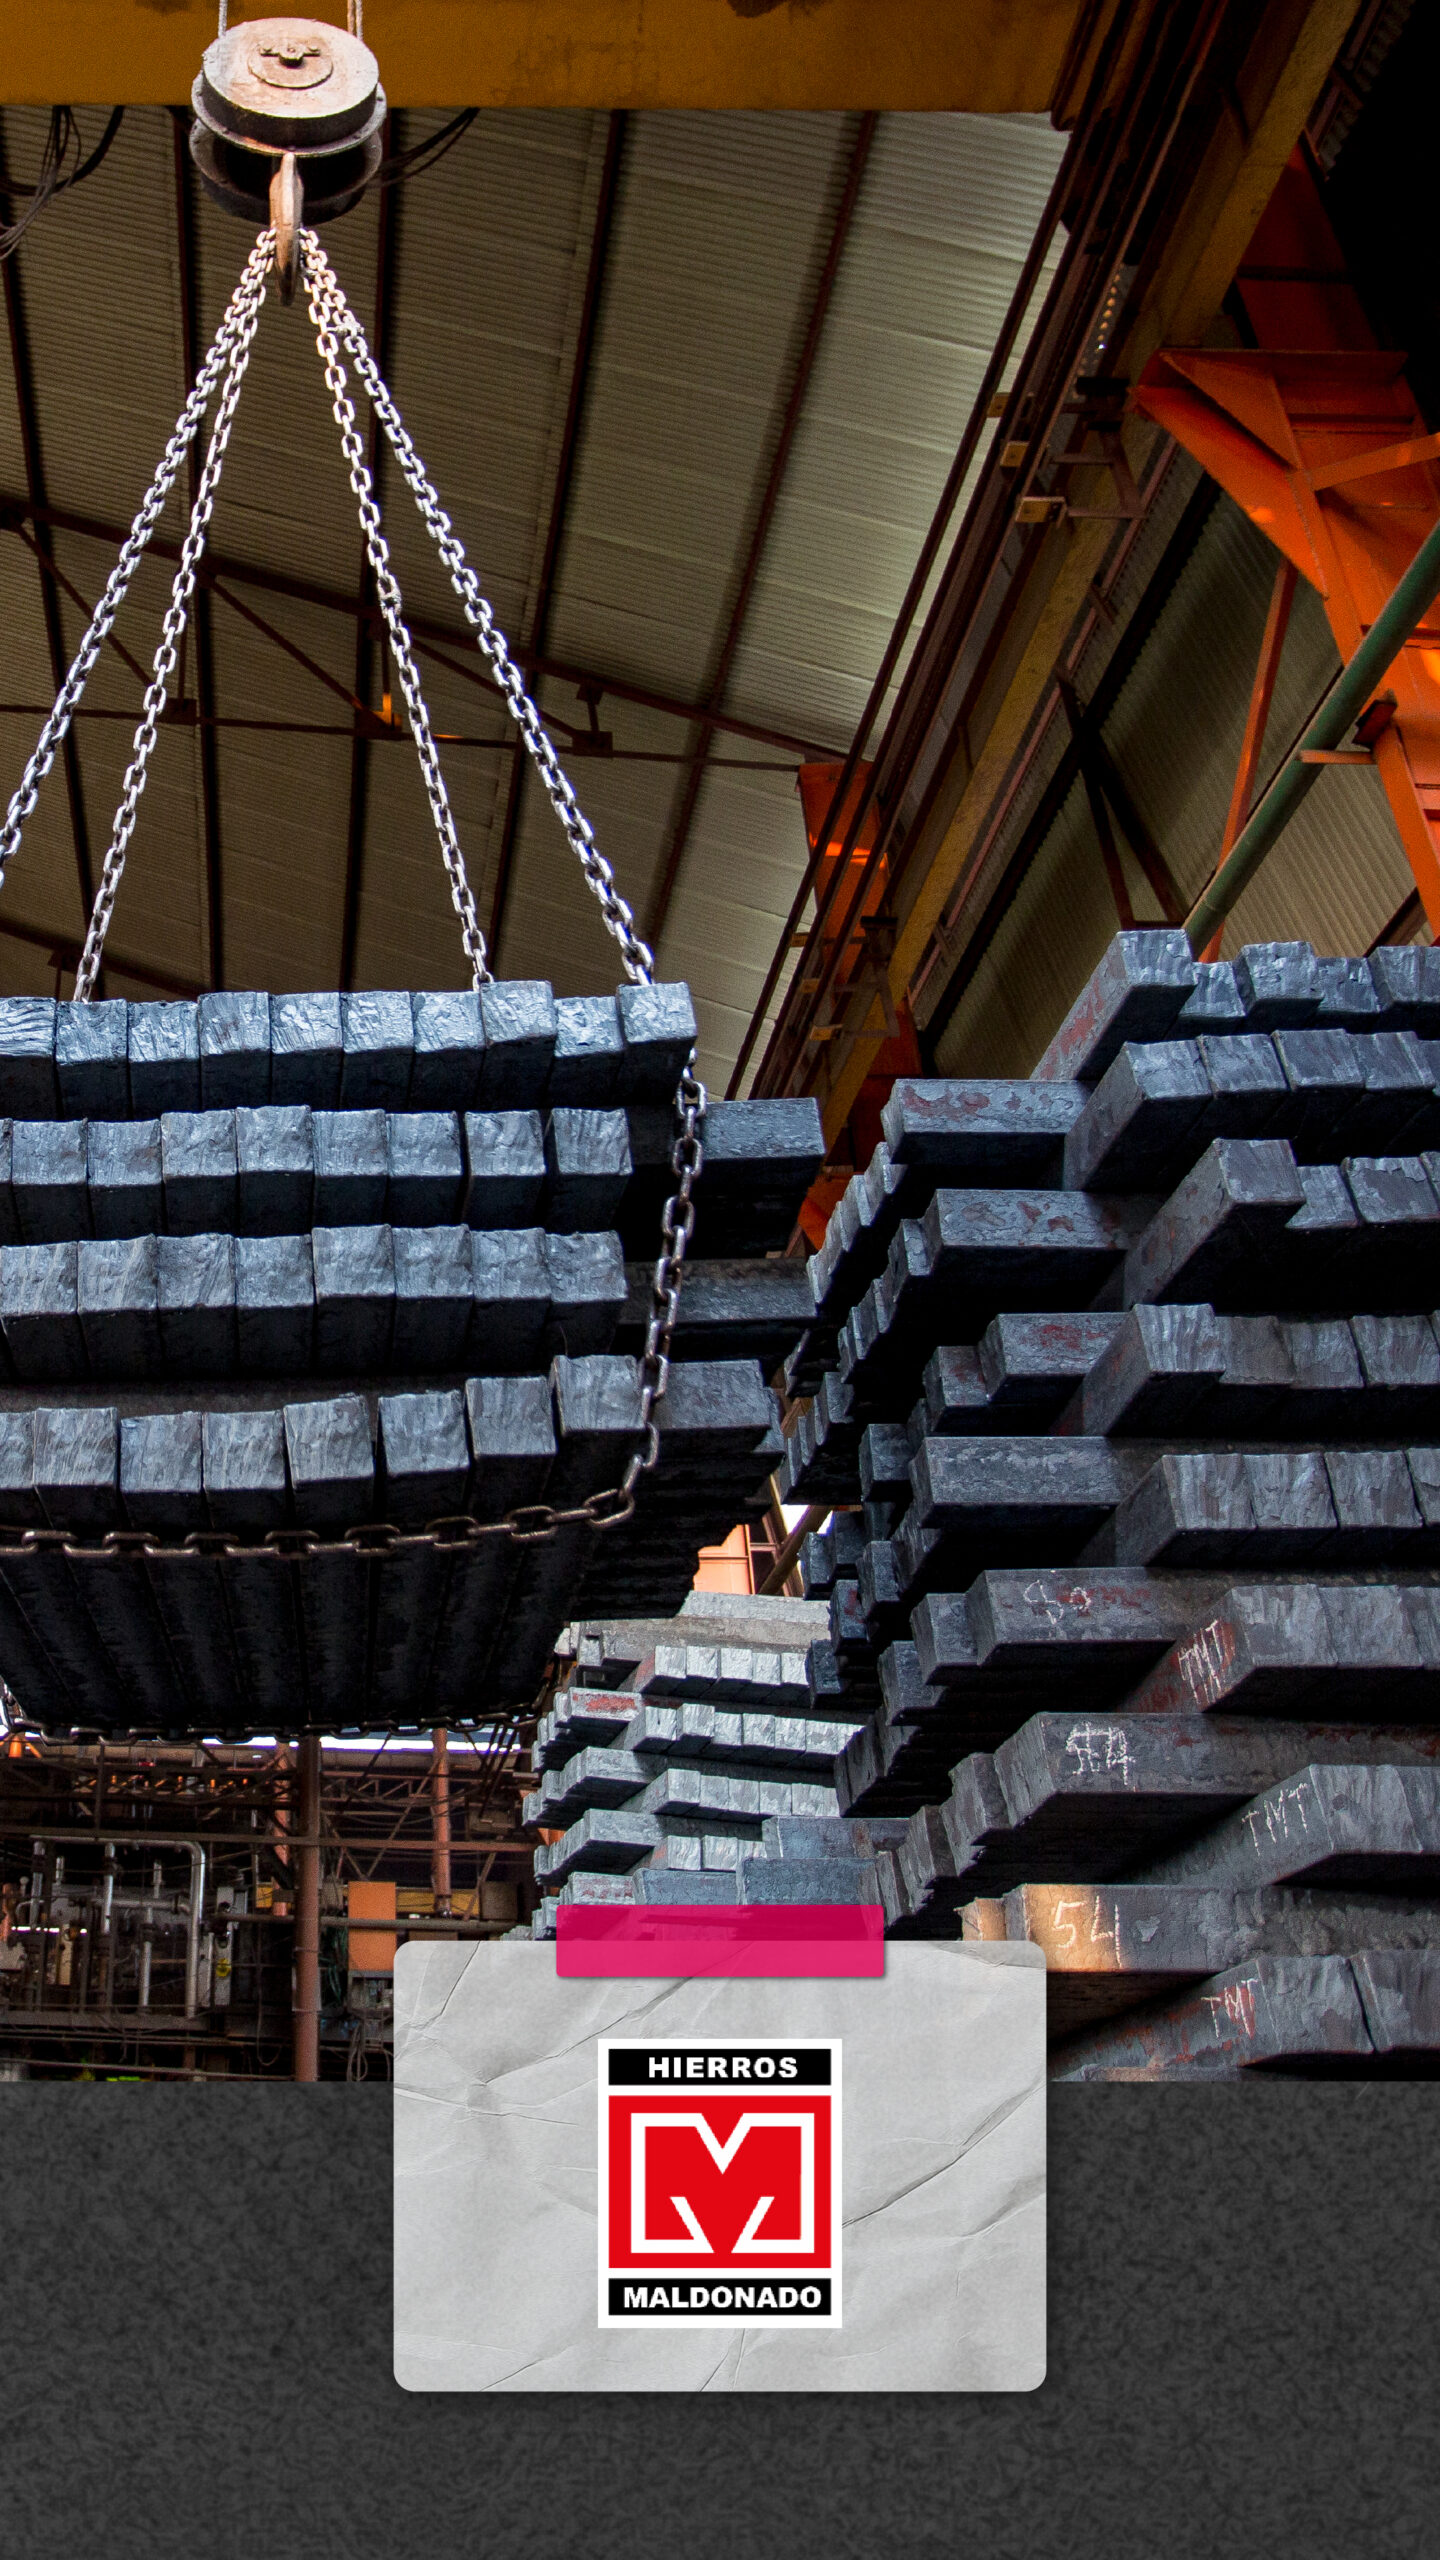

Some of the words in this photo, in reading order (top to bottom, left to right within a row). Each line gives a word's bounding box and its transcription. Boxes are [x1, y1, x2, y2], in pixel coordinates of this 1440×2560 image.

[1241, 1783, 1309, 1857] TMT
[1051, 1895, 1122, 1968] 54
[1200, 1978, 1259, 2039] TMT
